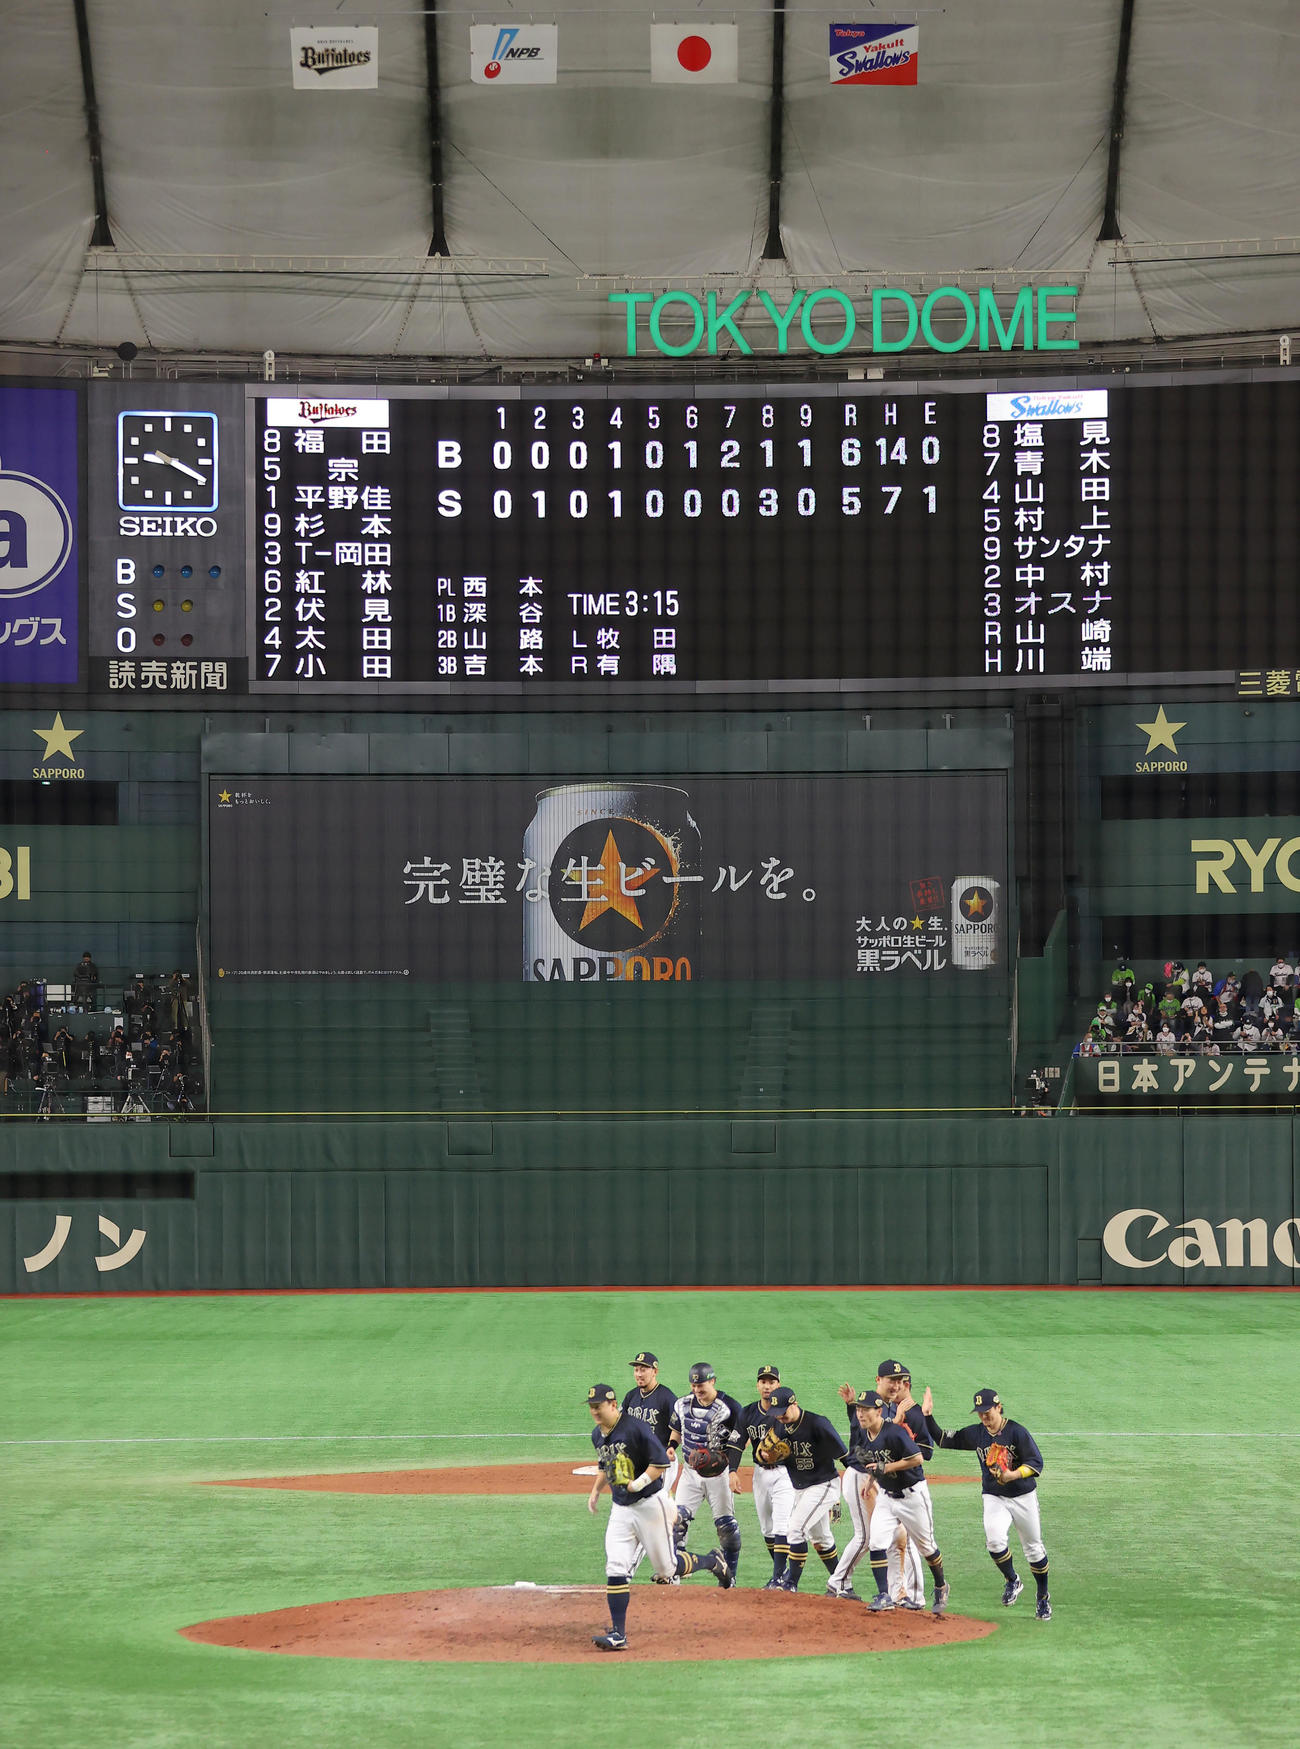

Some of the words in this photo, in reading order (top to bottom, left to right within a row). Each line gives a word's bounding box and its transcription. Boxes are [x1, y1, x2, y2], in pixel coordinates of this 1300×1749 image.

[505, 47, 541, 58] NPB
[863, 39, 904, 53] Yakult
[837, 50, 910, 76] Swallows
[608, 288, 857, 357] TOKYO
[872, 286, 1081, 354] DOME
[497, 407, 505, 429] 1
[534, 405, 546, 429] 2
[572, 405, 584, 429] 3
[610, 407, 622, 429] 4
[648, 406, 660, 429] 5
[686, 406, 697, 428] 6
[724, 405, 736, 428] 7
[762, 404, 773, 428] 8
[800, 404, 811, 427] 9
[845, 404, 856, 426] R
[885, 403, 896, 425] H
[925, 402, 936, 424] E
[1010, 395, 1083, 419] Swallows
[264, 429, 280, 452] 8
[983, 424, 1000, 448] 8
[437, 440, 462, 468] B
[493, 440, 511, 469] 0
[531, 441, 549, 469] 0
[569, 440, 587, 469] 0
[608, 441, 621, 468] 1
[646, 440, 663, 468] 0
[684, 440, 697, 468] 1
[721, 440, 740, 467] 2
[760, 438, 773, 467] 1
[798, 439, 811, 466] 1
[841, 438, 861, 466] 6
[876, 437, 907, 465] 14
[922, 436, 940, 464] 0
[984, 452, 1000, 475] 7
[264, 456, 280, 480] 5
[267, 485, 275, 508] 1
[438, 488, 462, 517] S
[493, 490, 512, 518] 0
[532, 490, 545, 518] 1
[569, 490, 588, 518] 0
[608, 490, 621, 517] 1
[646, 489, 663, 518] 0
[684, 489, 702, 517] 0
[722, 489, 739, 517] 0
[759, 488, 778, 516] 3
[798, 488, 815, 516] 0
[842, 486, 861, 515] 5
[882, 486, 902, 514] 7
[923, 486, 936, 513] 1
[983, 481, 1000, 503] 4
[120, 512, 217, 537] SEIKO
[264, 512, 281, 536] 9
[984, 508, 1000, 532] 5
[264, 541, 281, 565] 3
[984, 537, 1000, 560] 9
[115, 559, 135, 584] B
[265, 569, 281, 593] 6
[984, 565, 1001, 588] 2
[438, 578, 456, 596] PL
[117, 592, 136, 618] S
[265, 597, 281, 621] 2
[438, 604, 456, 622] 1B
[567, 593, 620, 615] TIME
[625, 590, 678, 616] 3:15
[984, 593, 1000, 616] 3
[117, 627, 136, 652] O
[264, 626, 281, 649] 4
[438, 630, 457, 648] 2B
[573, 630, 587, 647] L
[985, 621, 1001, 644] R
[265, 654, 281, 677] 7
[438, 656, 457, 674] 3B
[572, 656, 587, 673] R
[986, 649, 1001, 672] H
[109, 661, 228, 690] 読売新聞
[1238, 670, 1300, 695] 三菱
[32, 767, 85, 780] SAPPORO
[1135, 760, 1188, 773] SAPPORO
[402, 855, 817, 905] 完璧な生ビールを。
[856, 935, 947, 948] サッポロ生ビール
[857, 949, 947, 972] 黒ラベル
